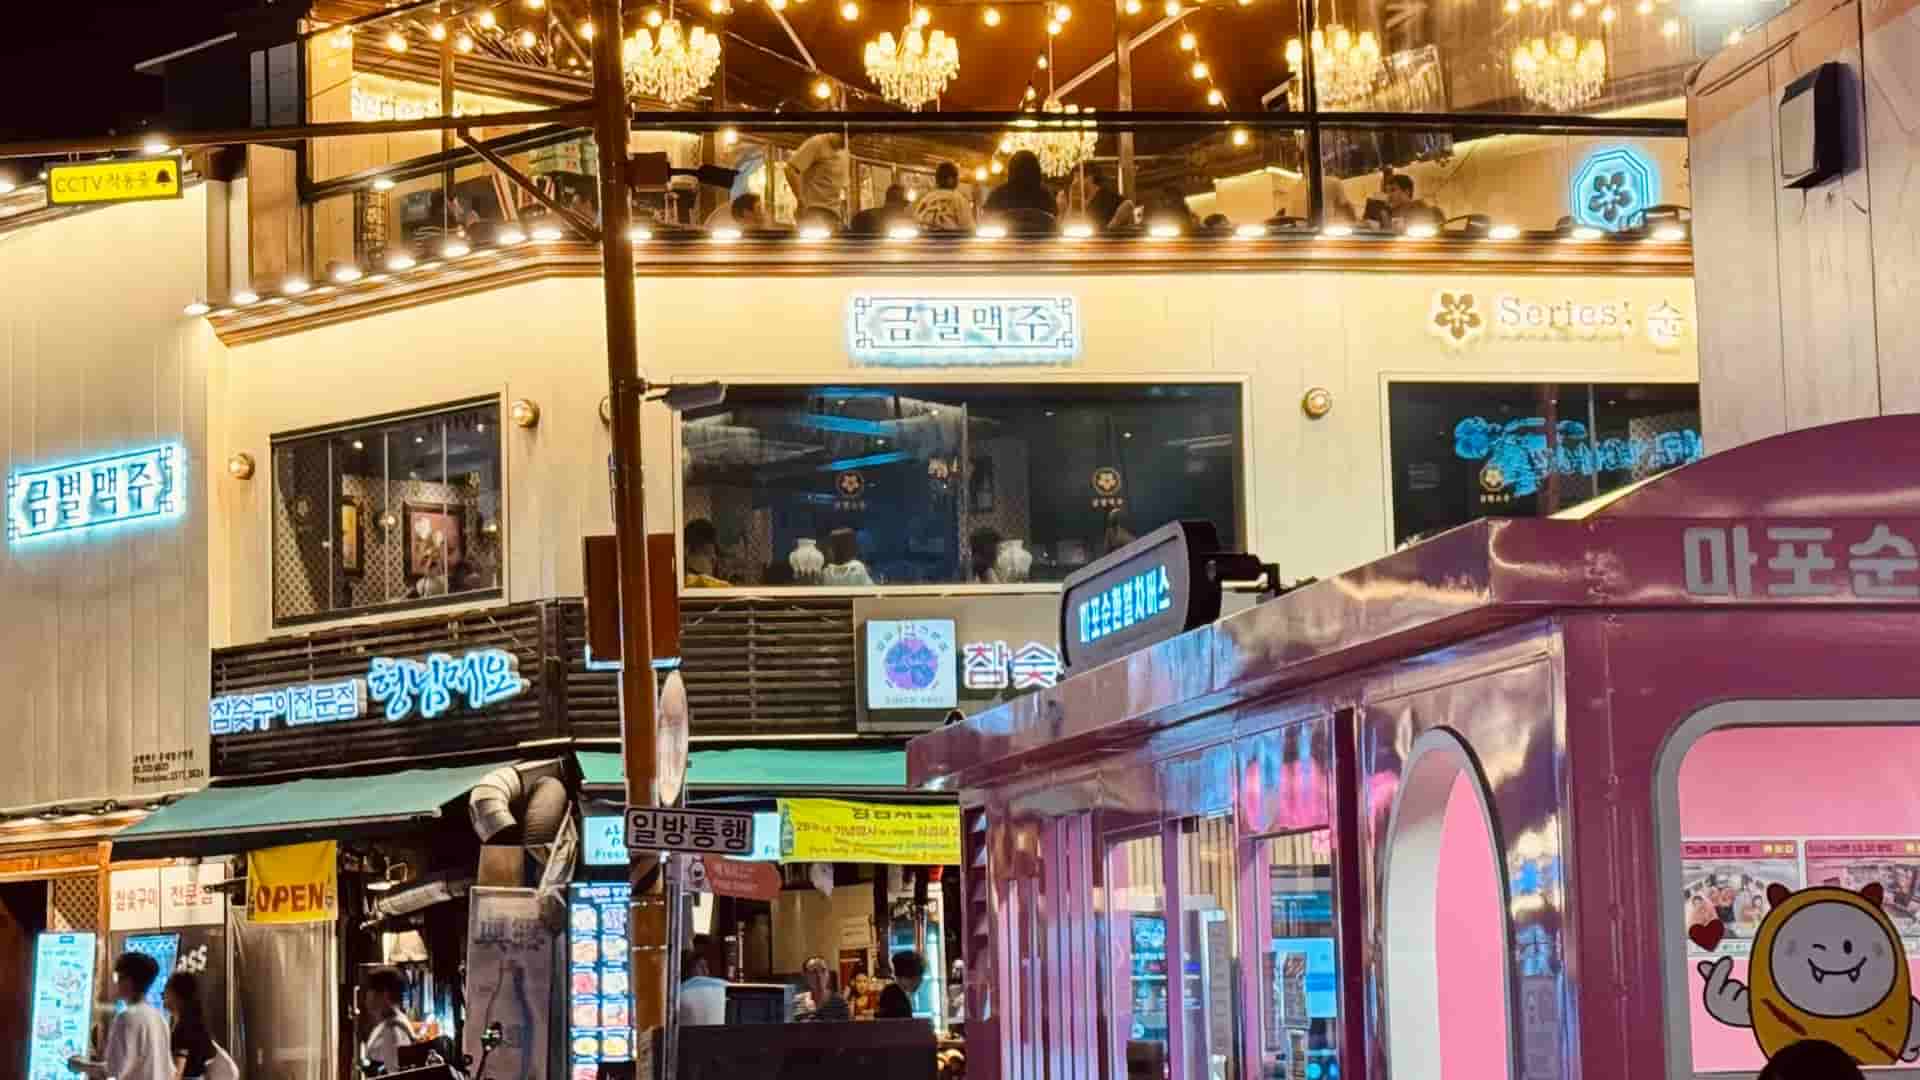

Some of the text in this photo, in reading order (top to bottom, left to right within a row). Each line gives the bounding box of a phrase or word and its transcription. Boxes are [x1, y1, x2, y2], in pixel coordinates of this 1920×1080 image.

[55, 175, 103, 193] CCTV
[880, 304, 1051, 342] 금별맥주
[28, 462, 155, 529] 금별맥주
[1684, 524, 1919, 596] 마포순
[964, 641, 1064, 688] 참숯
[632, 813, 747, 850] 일방통행
[255, 881, 325, 912] OPEN
